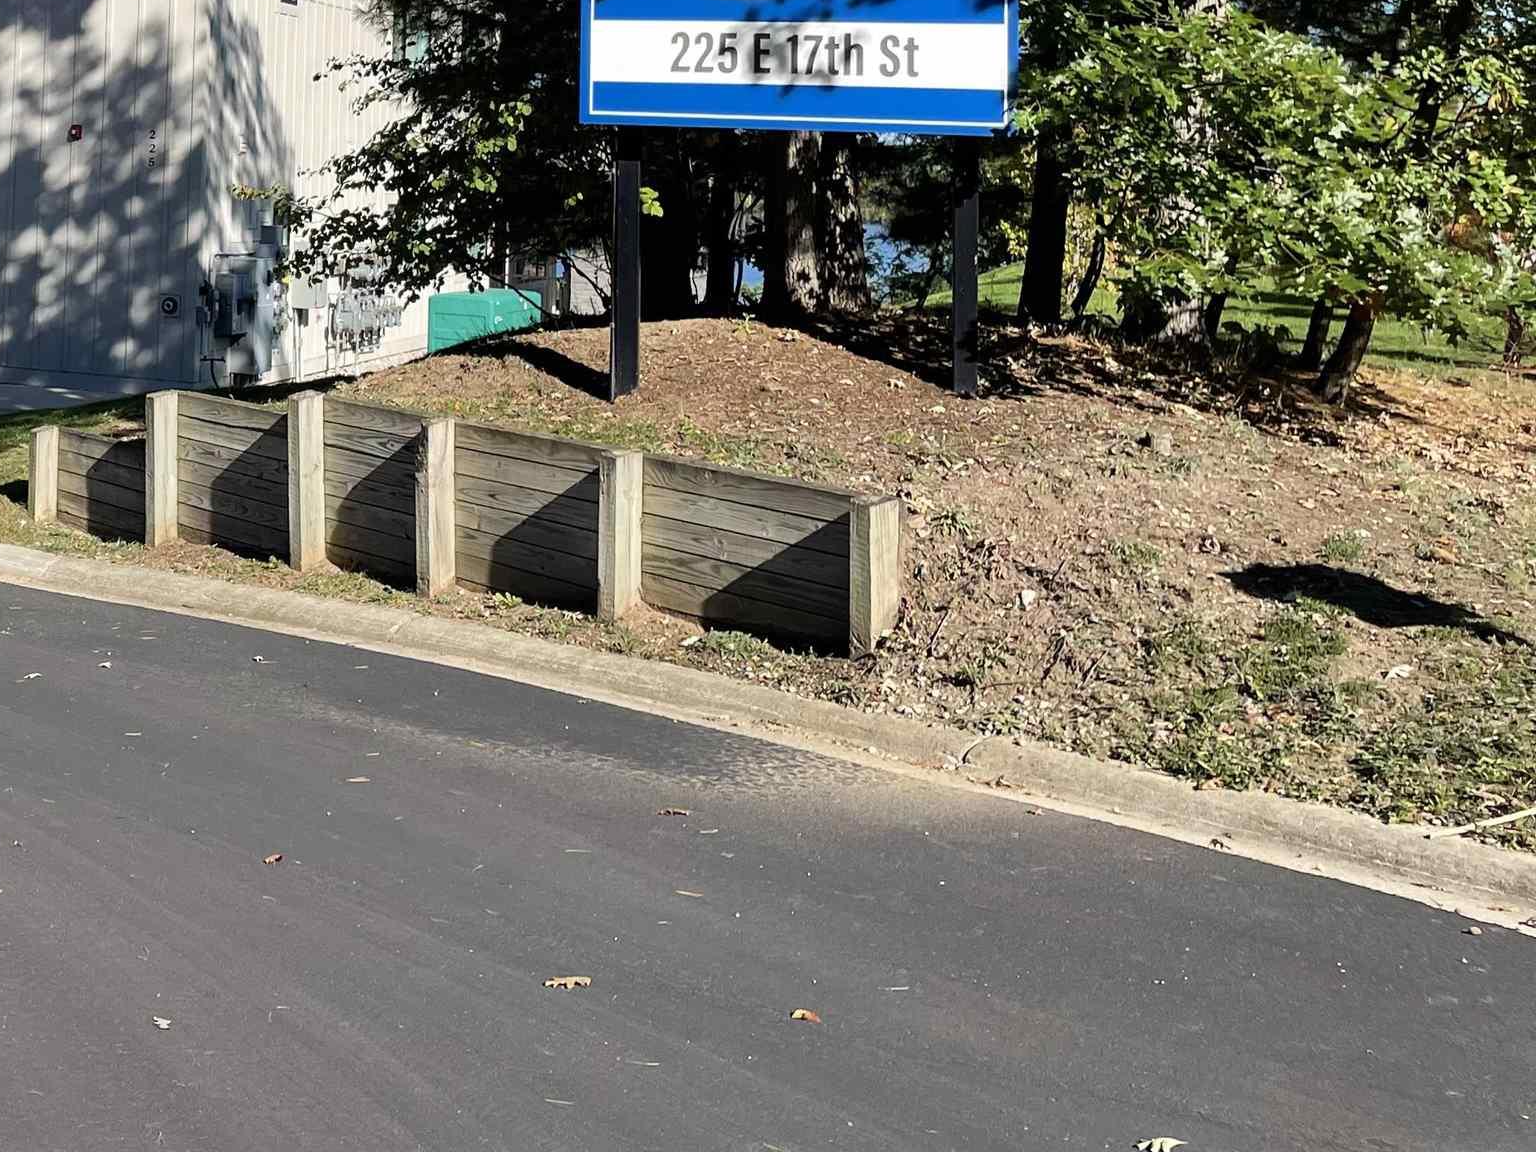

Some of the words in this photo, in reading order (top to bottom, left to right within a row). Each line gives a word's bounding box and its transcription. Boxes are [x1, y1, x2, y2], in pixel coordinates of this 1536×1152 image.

[670, 31, 739, 73] 225
[753, 33, 771, 74] E
[786, 32, 864, 77] 17th
[880, 34, 919, 78] St
